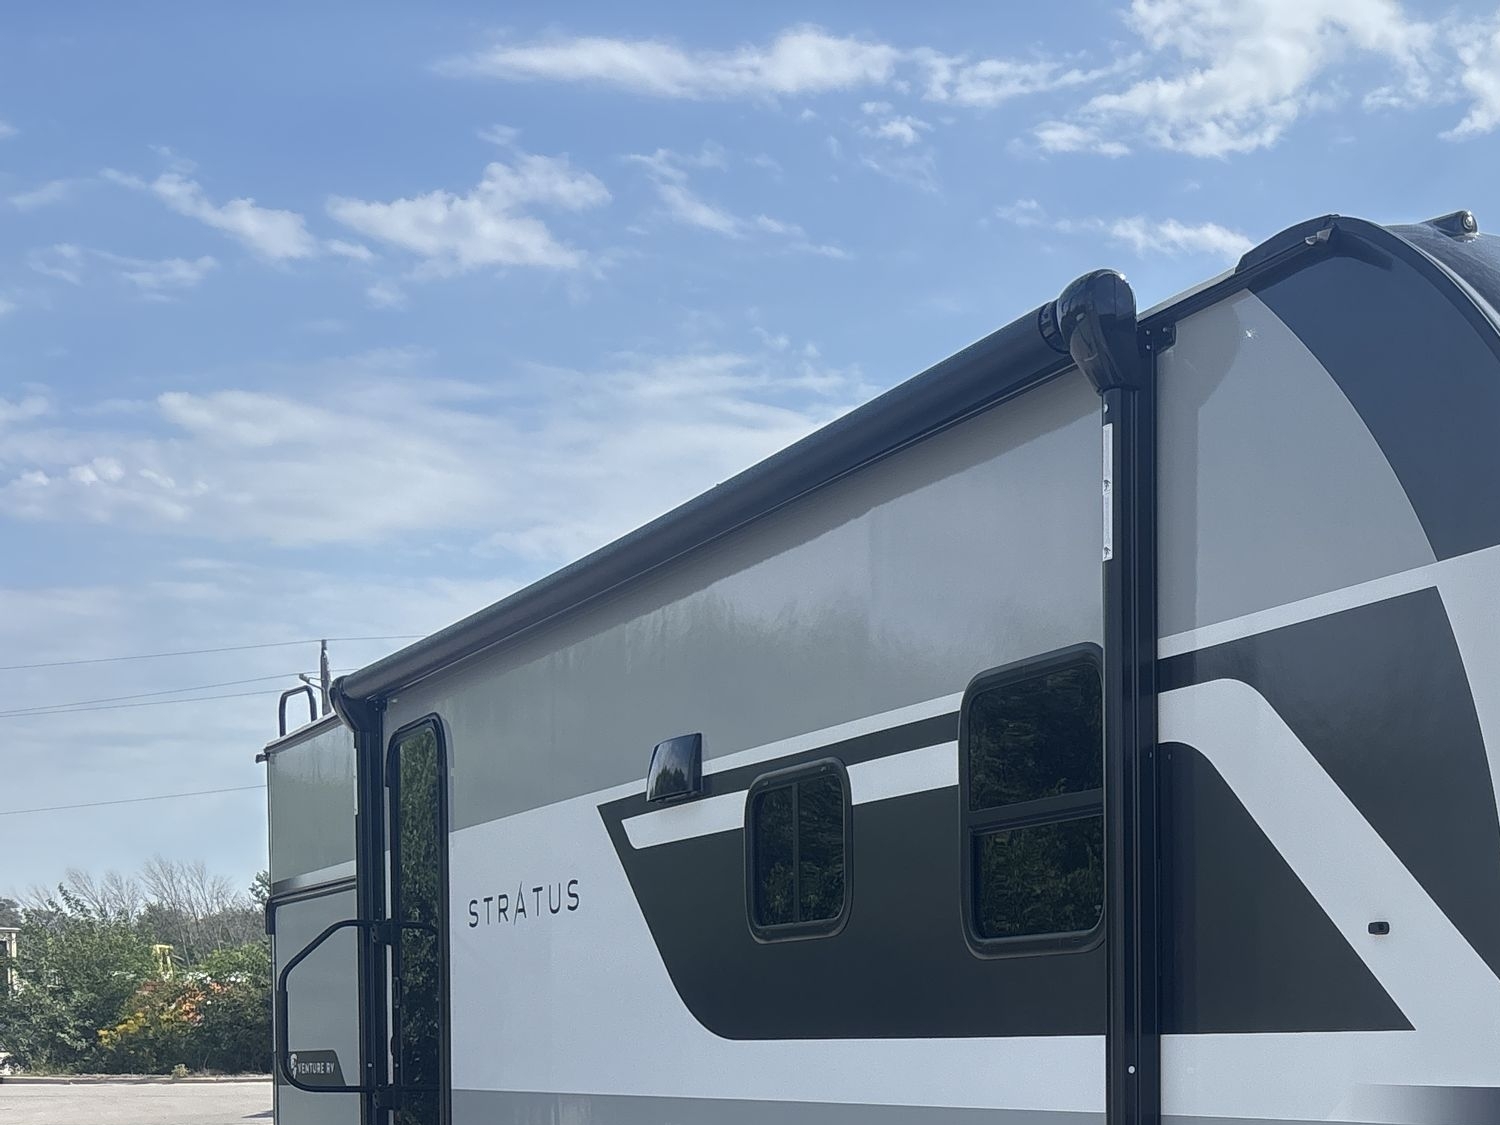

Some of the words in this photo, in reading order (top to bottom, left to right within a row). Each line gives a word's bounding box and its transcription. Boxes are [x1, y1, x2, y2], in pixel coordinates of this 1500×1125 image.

[468, 879, 580, 928] STRATUS
[297, 1062, 325, 1074] VENTURE
[326, 1062, 335, 1074] RV
